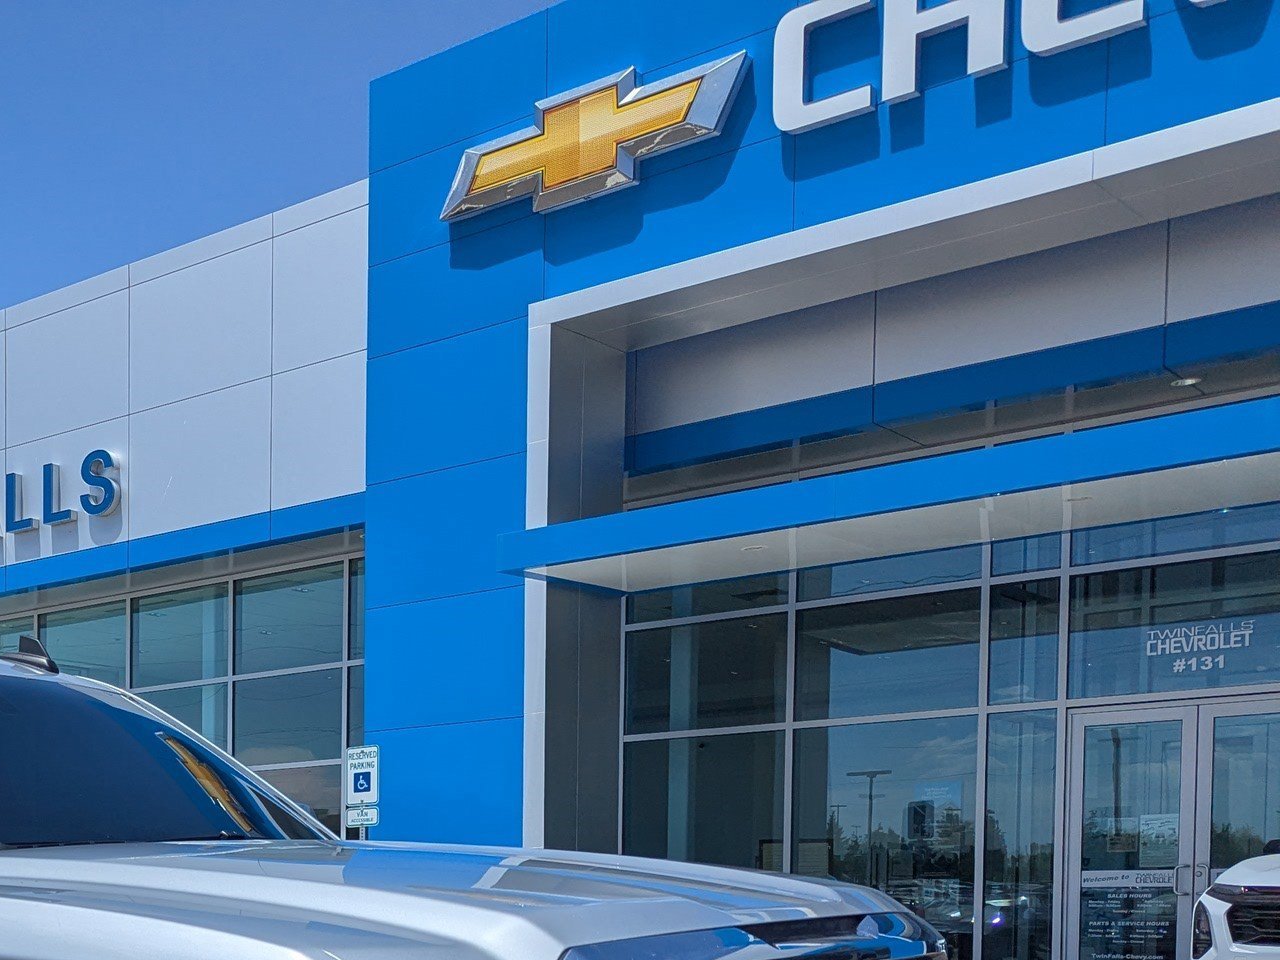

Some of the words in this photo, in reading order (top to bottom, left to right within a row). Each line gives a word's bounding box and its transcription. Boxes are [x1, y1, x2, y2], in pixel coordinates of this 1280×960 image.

[1146, 630, 1253, 656] CHEVROLET
[1173, 655, 1224, 673] #131
[348, 750, 377, 760] RESERVED
[349, 761, 375, 770] PARKING
[1083, 875, 1119, 884] Welcome
[1135, 876, 1174, 884] CHEVROLE
